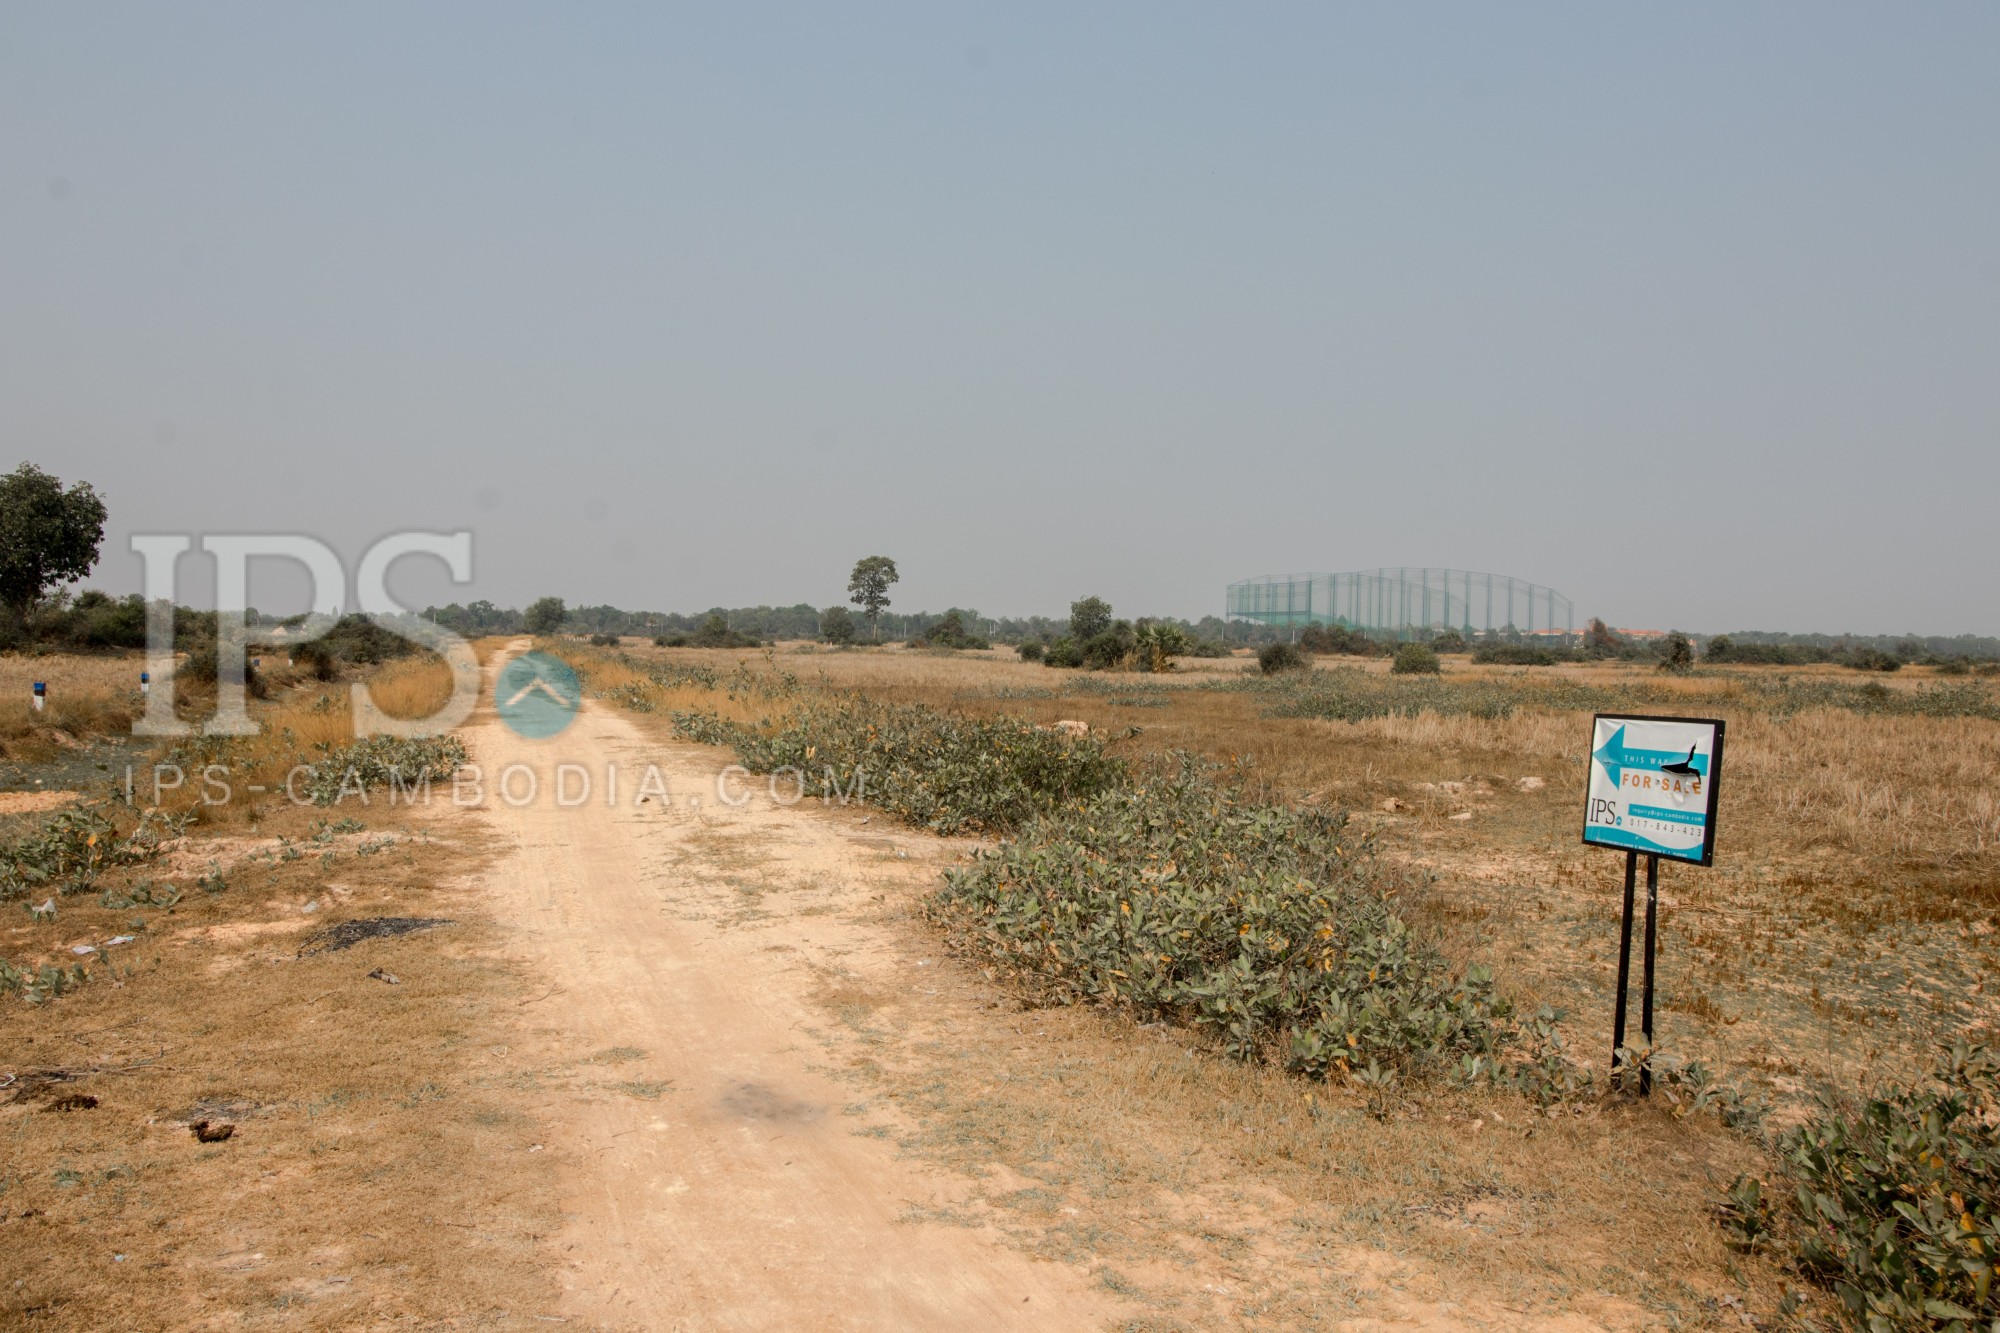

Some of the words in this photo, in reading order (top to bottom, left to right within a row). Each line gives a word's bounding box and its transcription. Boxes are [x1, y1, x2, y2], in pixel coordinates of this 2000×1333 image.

[1624, 755, 1645, 764] THIS
[1622, 773, 1652, 788] FOR
[1589, 798, 1616, 825] IPS
